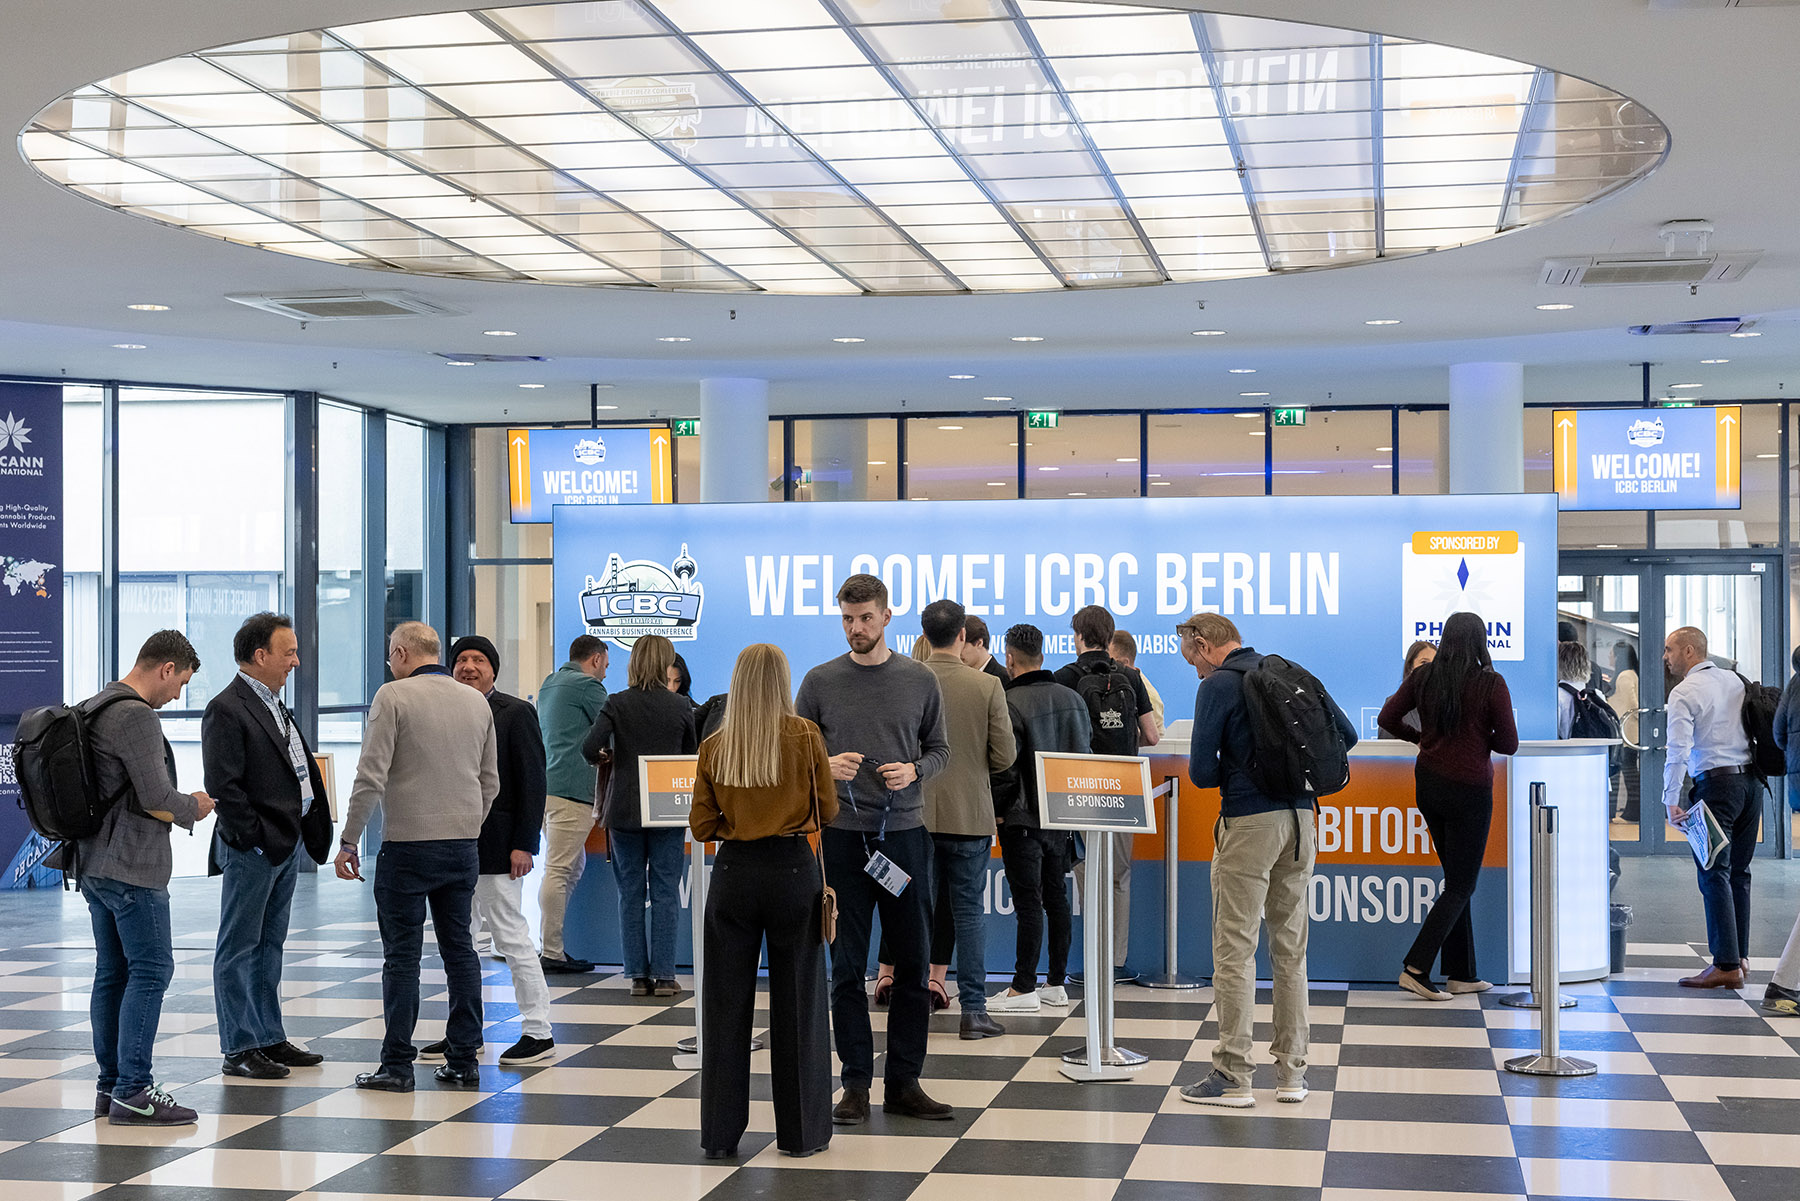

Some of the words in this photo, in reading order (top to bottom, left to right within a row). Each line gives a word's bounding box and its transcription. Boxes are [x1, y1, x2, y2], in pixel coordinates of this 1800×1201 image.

[1592, 453, 1700, 480] WELCOME!
[543, 470, 638, 494] WELCOME!
[1615, 480, 1639, 494] ICBC
[1641, 479, 1678, 493] BERLIN
[5, 504, 49, 513] High-Quality
[28, 513, 56, 521] Products
[1429, 537, 1486, 550] SPONSORED
[1486, 536, 1500, 550] BY
[1024, 553, 1139, 616] ICBC
[1156, 551, 1340, 616] BERLIN
[598, 594, 683, 616] ICBC
[588, 628, 620, 636] CANNABIS
[621, 627, 652, 636] BUSINESS
[653, 628, 693, 636] CONFERENCE
[1044, 634, 1076, 654] MEE
[1067, 776, 1122, 791] EXHIBITORS
[674, 794, 681, 805] &
[1067, 794, 1075, 807] &
[1076, 795, 1125, 809] SPONSORS
